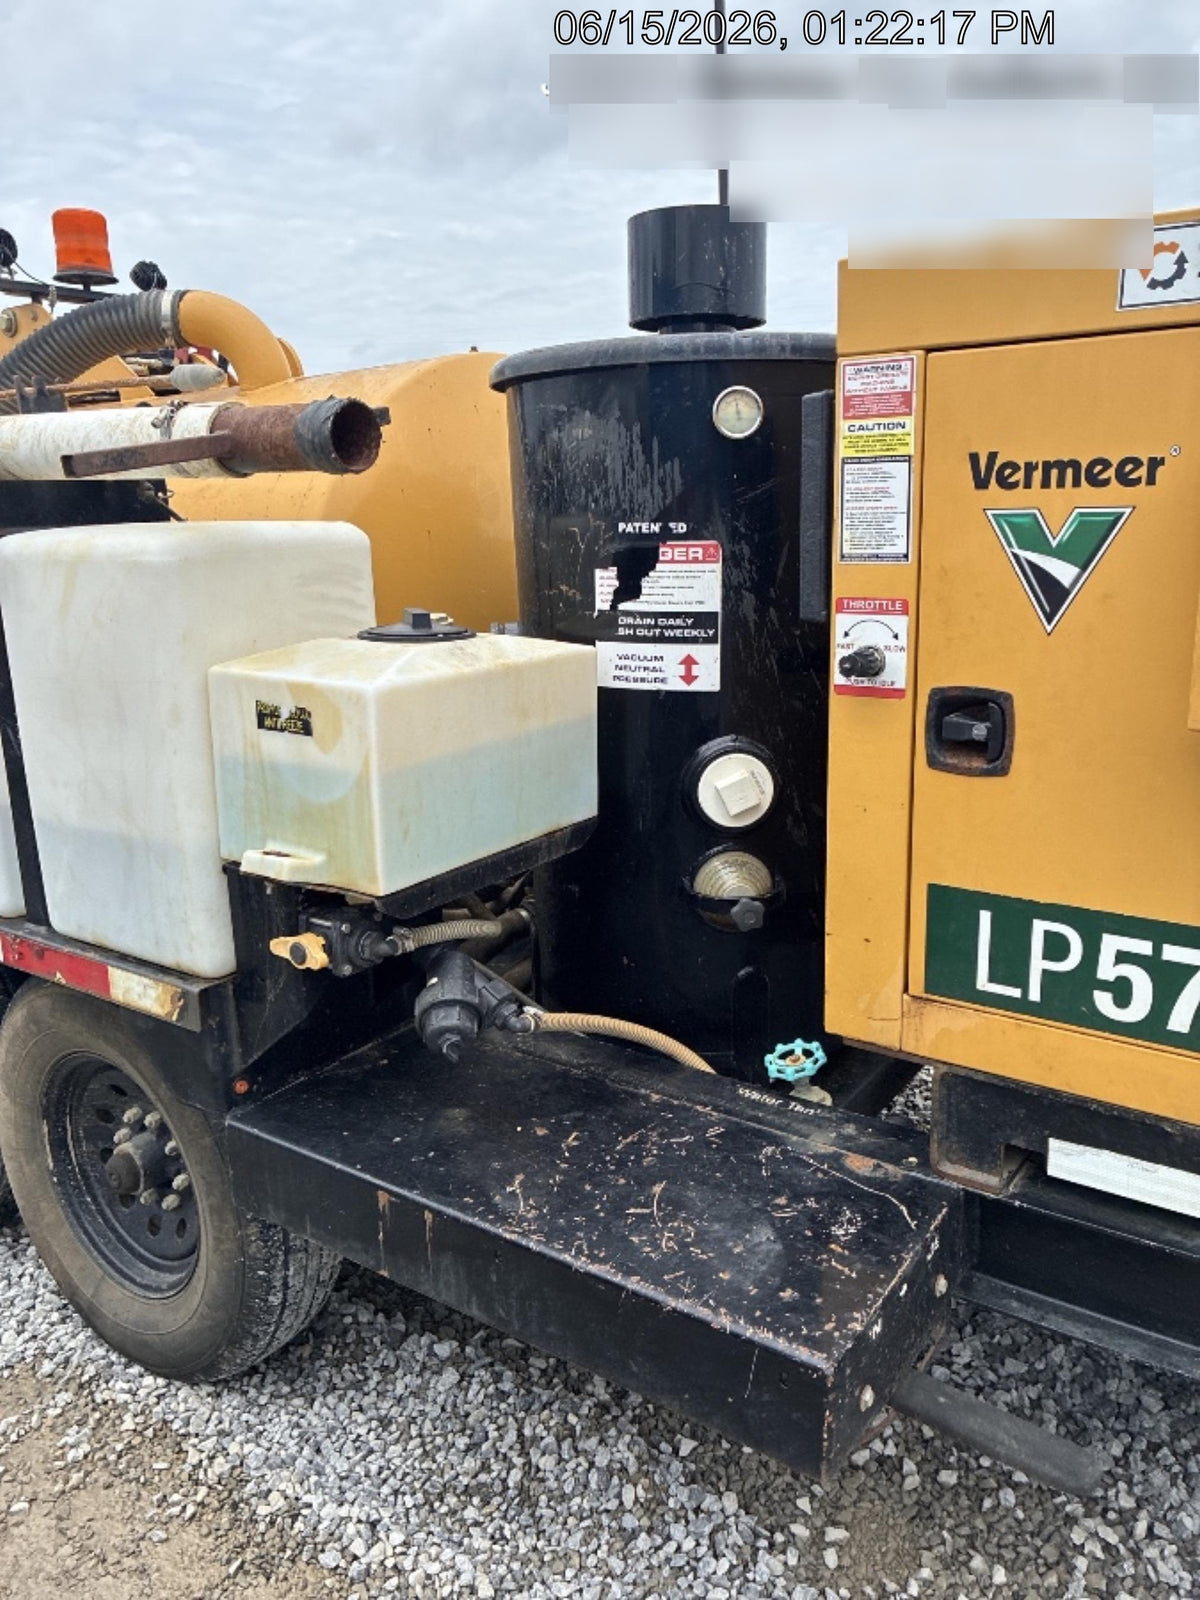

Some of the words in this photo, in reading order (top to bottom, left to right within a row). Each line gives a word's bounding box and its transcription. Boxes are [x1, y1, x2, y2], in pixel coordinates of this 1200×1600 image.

[847, 421, 906, 433] CAUTION
[968, 450, 1166, 491] Vermeer
[618, 522, 687, 534] PATENED
[842, 599, 903, 611] THROTTLE
[618, 616, 655, 625] DRAIN
[657, 617, 694, 626] DAILY
[636, 628, 661, 637] OUT
[663, 628, 716, 638] WEEKLY
[616, 653, 664, 662] VACUUM
[614, 665, 665, 673] NEUTRAL
